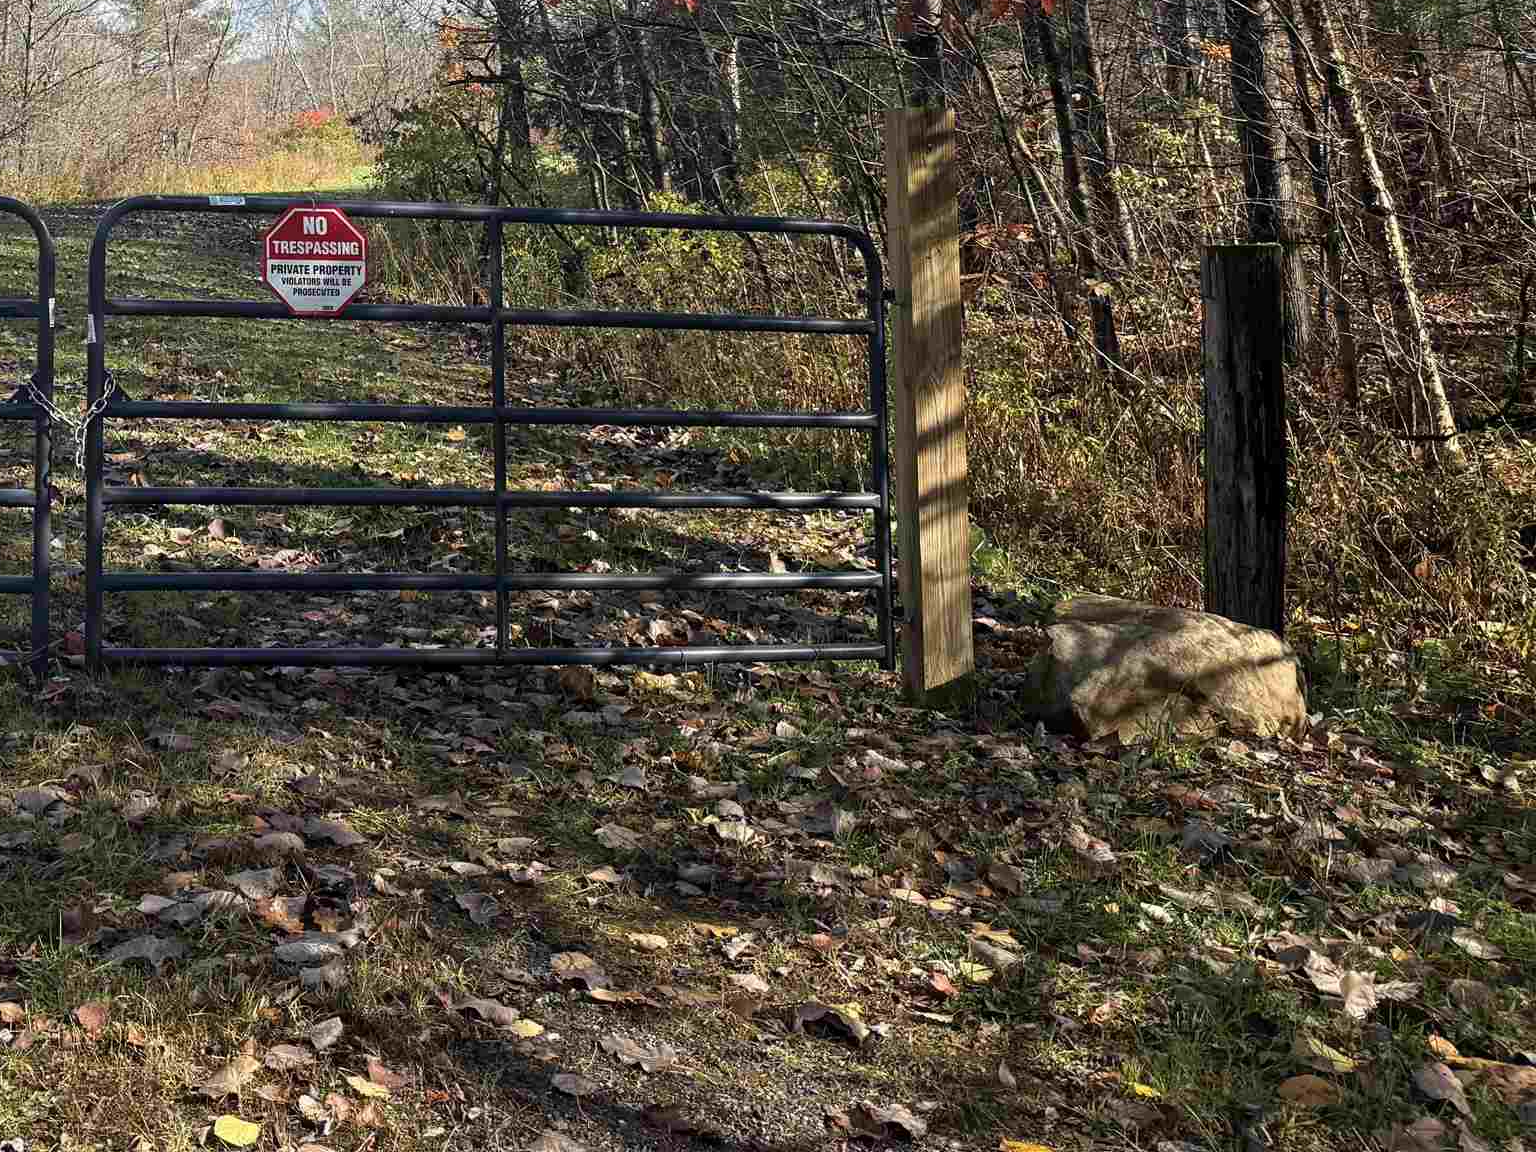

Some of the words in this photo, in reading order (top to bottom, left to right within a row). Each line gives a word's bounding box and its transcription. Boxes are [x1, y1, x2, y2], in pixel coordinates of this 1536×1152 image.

[303, 216, 327, 235] NO
[272, 240, 359, 255] TRESPASSING
[271, 264, 310, 274] PRIVATE
[313, 264, 361, 276] PROPERTY
[281, 277, 321, 286] VIOLATORS
[323, 278, 340, 286] WILL
[342, 278, 352, 286] BE
[293, 288, 340, 296] PROSECUTED
